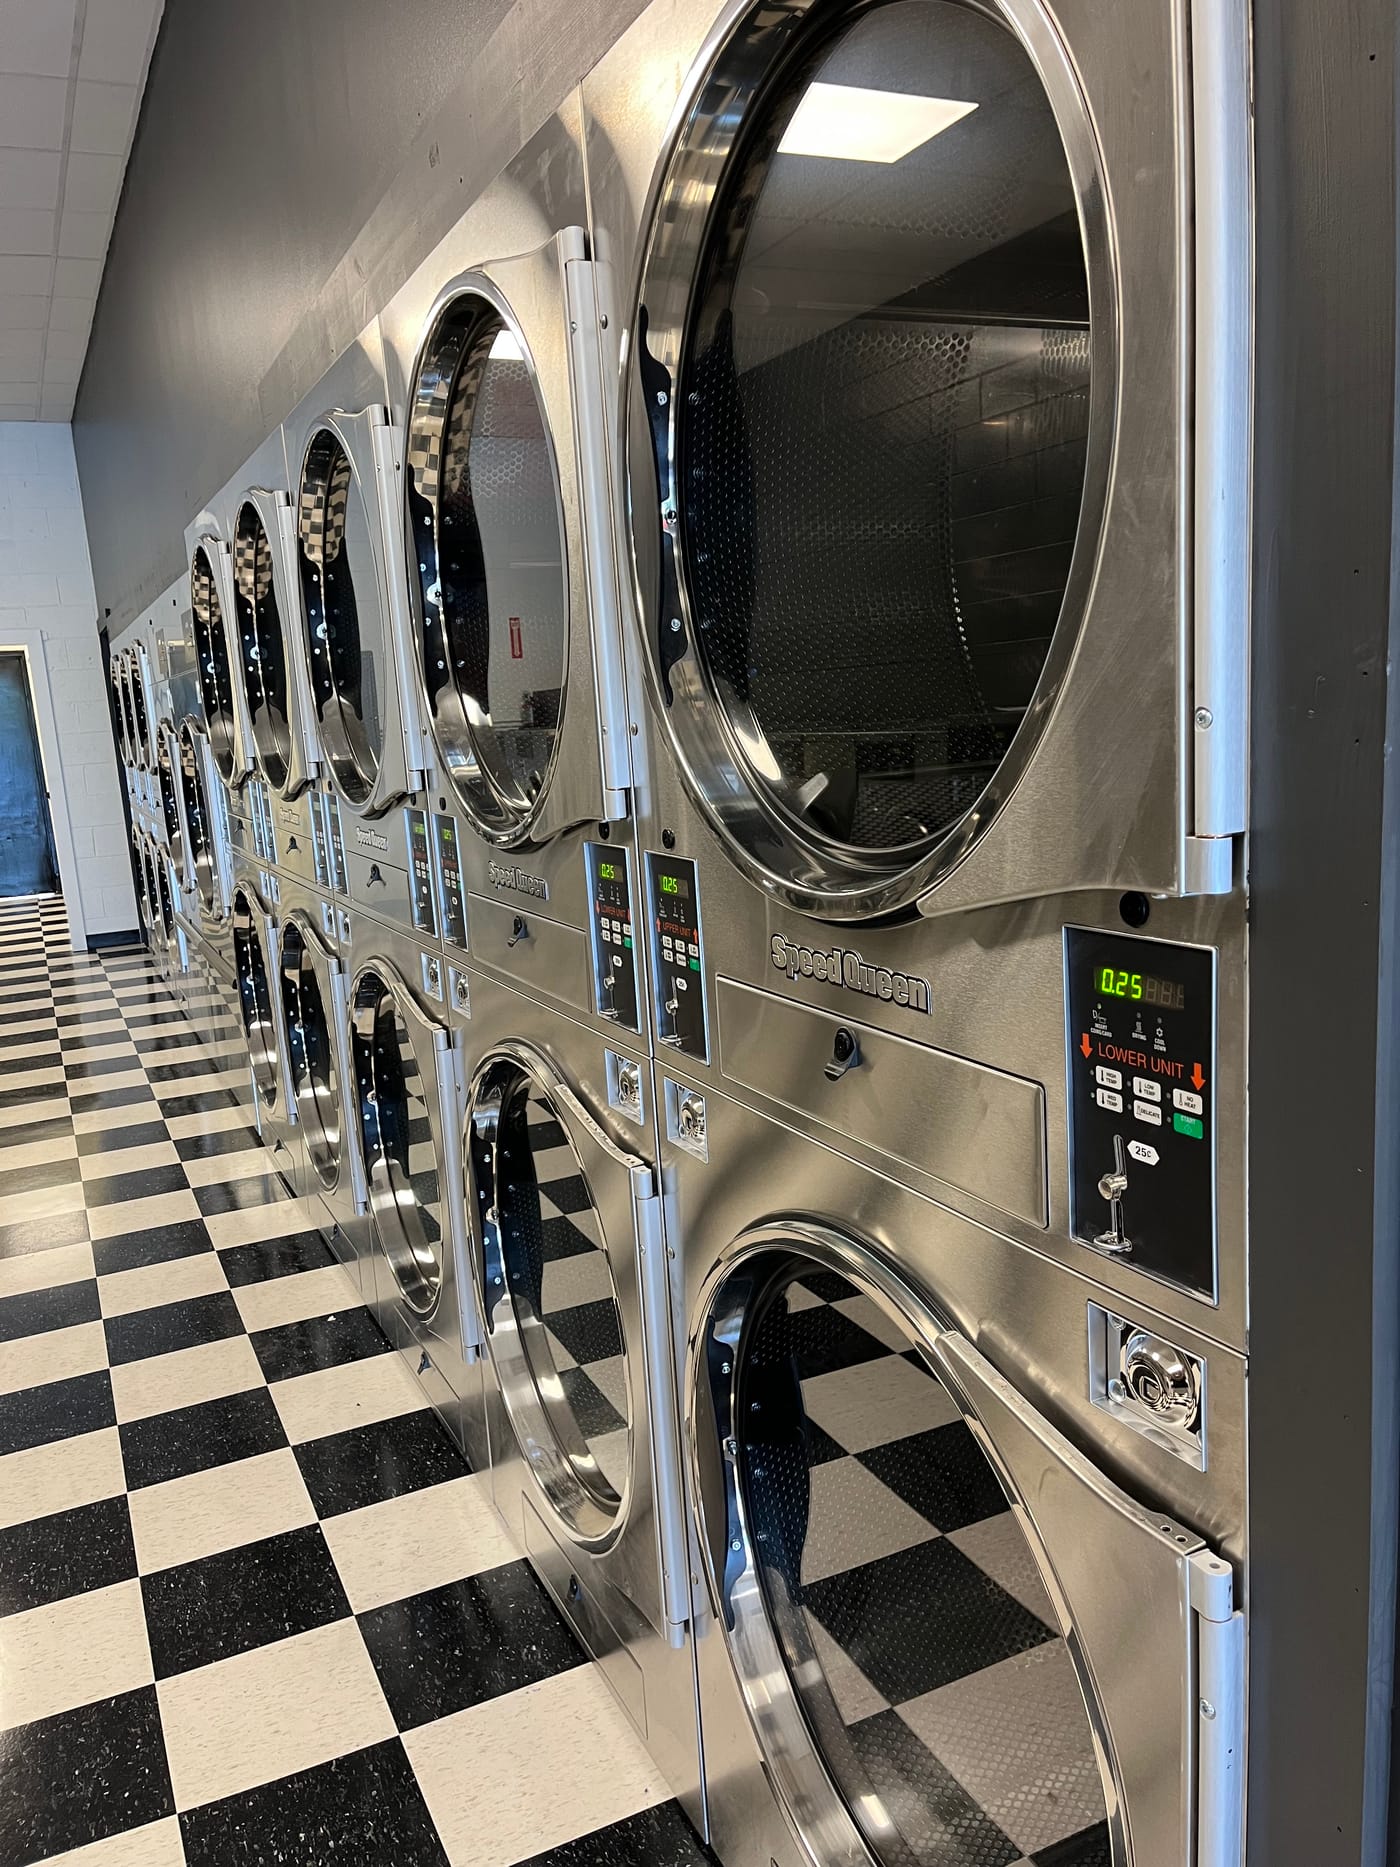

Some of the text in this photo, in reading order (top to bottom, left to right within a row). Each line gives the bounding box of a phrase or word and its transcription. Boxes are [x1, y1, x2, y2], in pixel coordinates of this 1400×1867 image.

[488, 860, 549, 901] Speed Queen
[663, 922, 680, 934] UPPER
[771, 932, 933, 1016] Speed Queen
[1101, 968, 1142, 999] 0.25
[1098, 1042, 1185, 1079] LOWER UNIT
[1105, 1077, 1118, 1085] TEMP
[1143, 1088, 1156, 1097] TEMP
[1186, 1095, 1194, 1103] NO
[1184, 1101, 1197, 1109] HEAT
[1140, 1108, 1160, 1119] DELICATE
